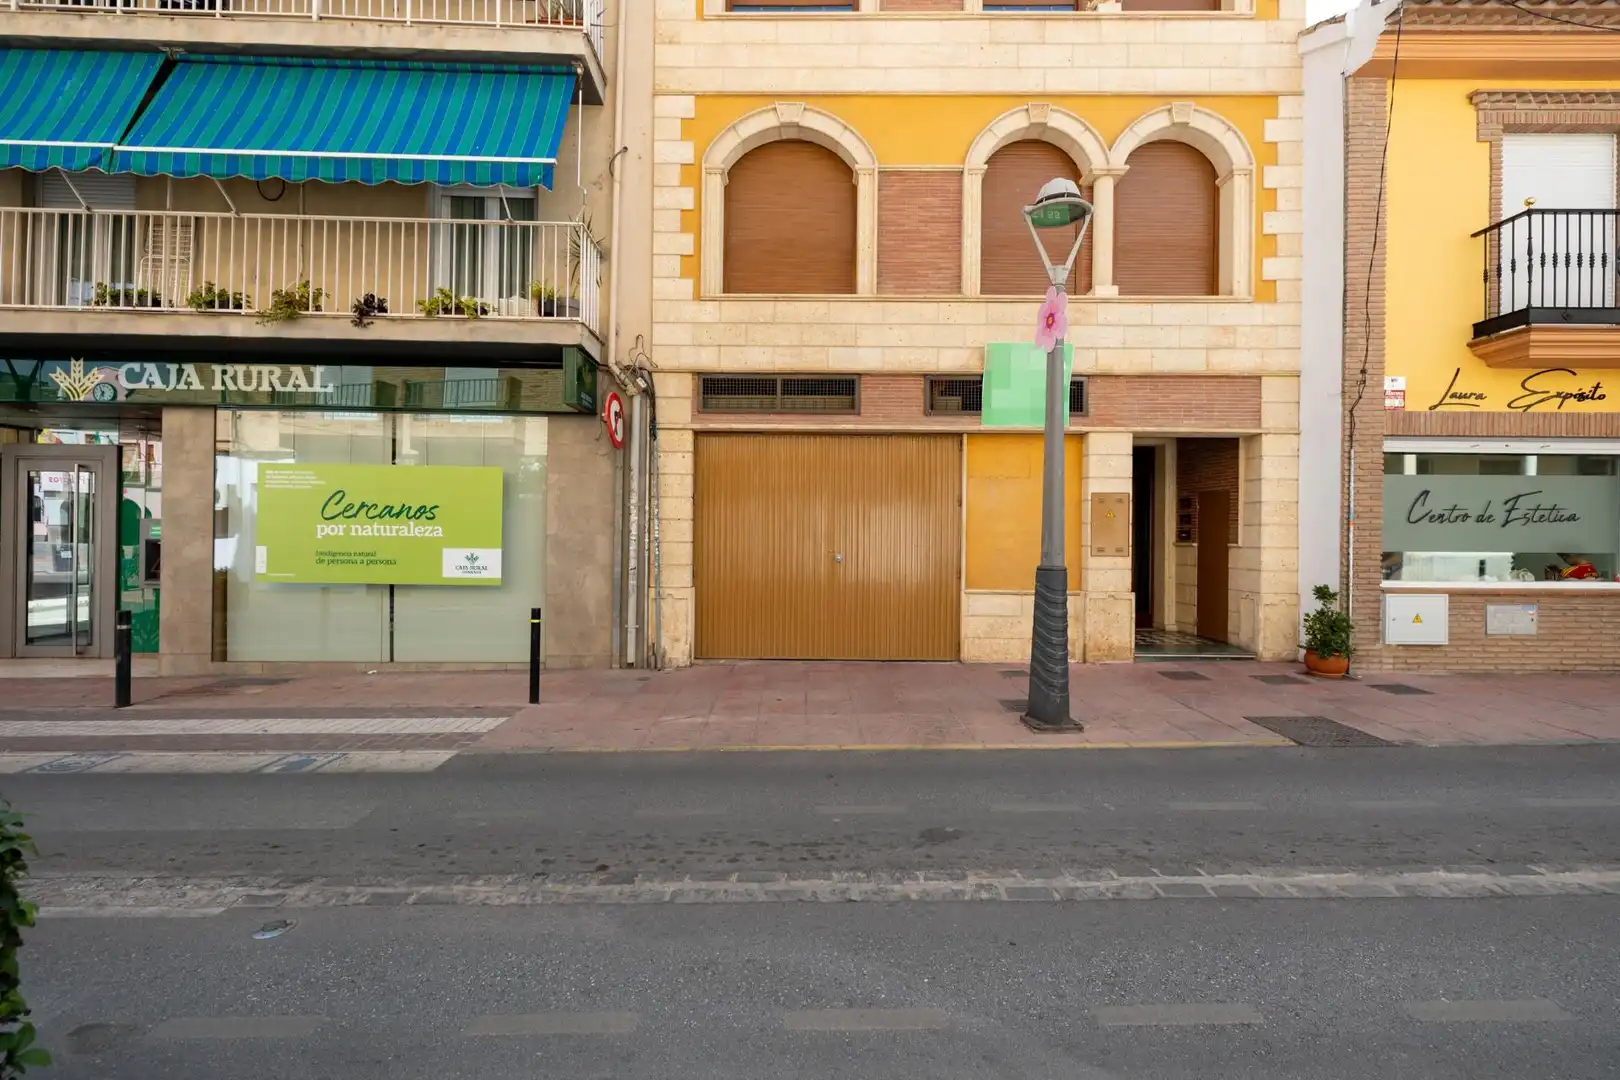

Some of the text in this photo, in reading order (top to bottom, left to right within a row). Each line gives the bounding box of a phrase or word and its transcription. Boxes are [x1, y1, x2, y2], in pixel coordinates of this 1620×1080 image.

[117, 363, 333, 392] CAJA RURAL
[1429, 368, 1487, 411] Laura
[320, 489, 440, 521] Cercanos
[1407, 490, 1472, 524] Centro
[1475, 500, 1496, 524] de
[316, 521, 443, 538] por naturaleza
[316, 557, 326, 565] de
[366, 559, 397, 567] persona
